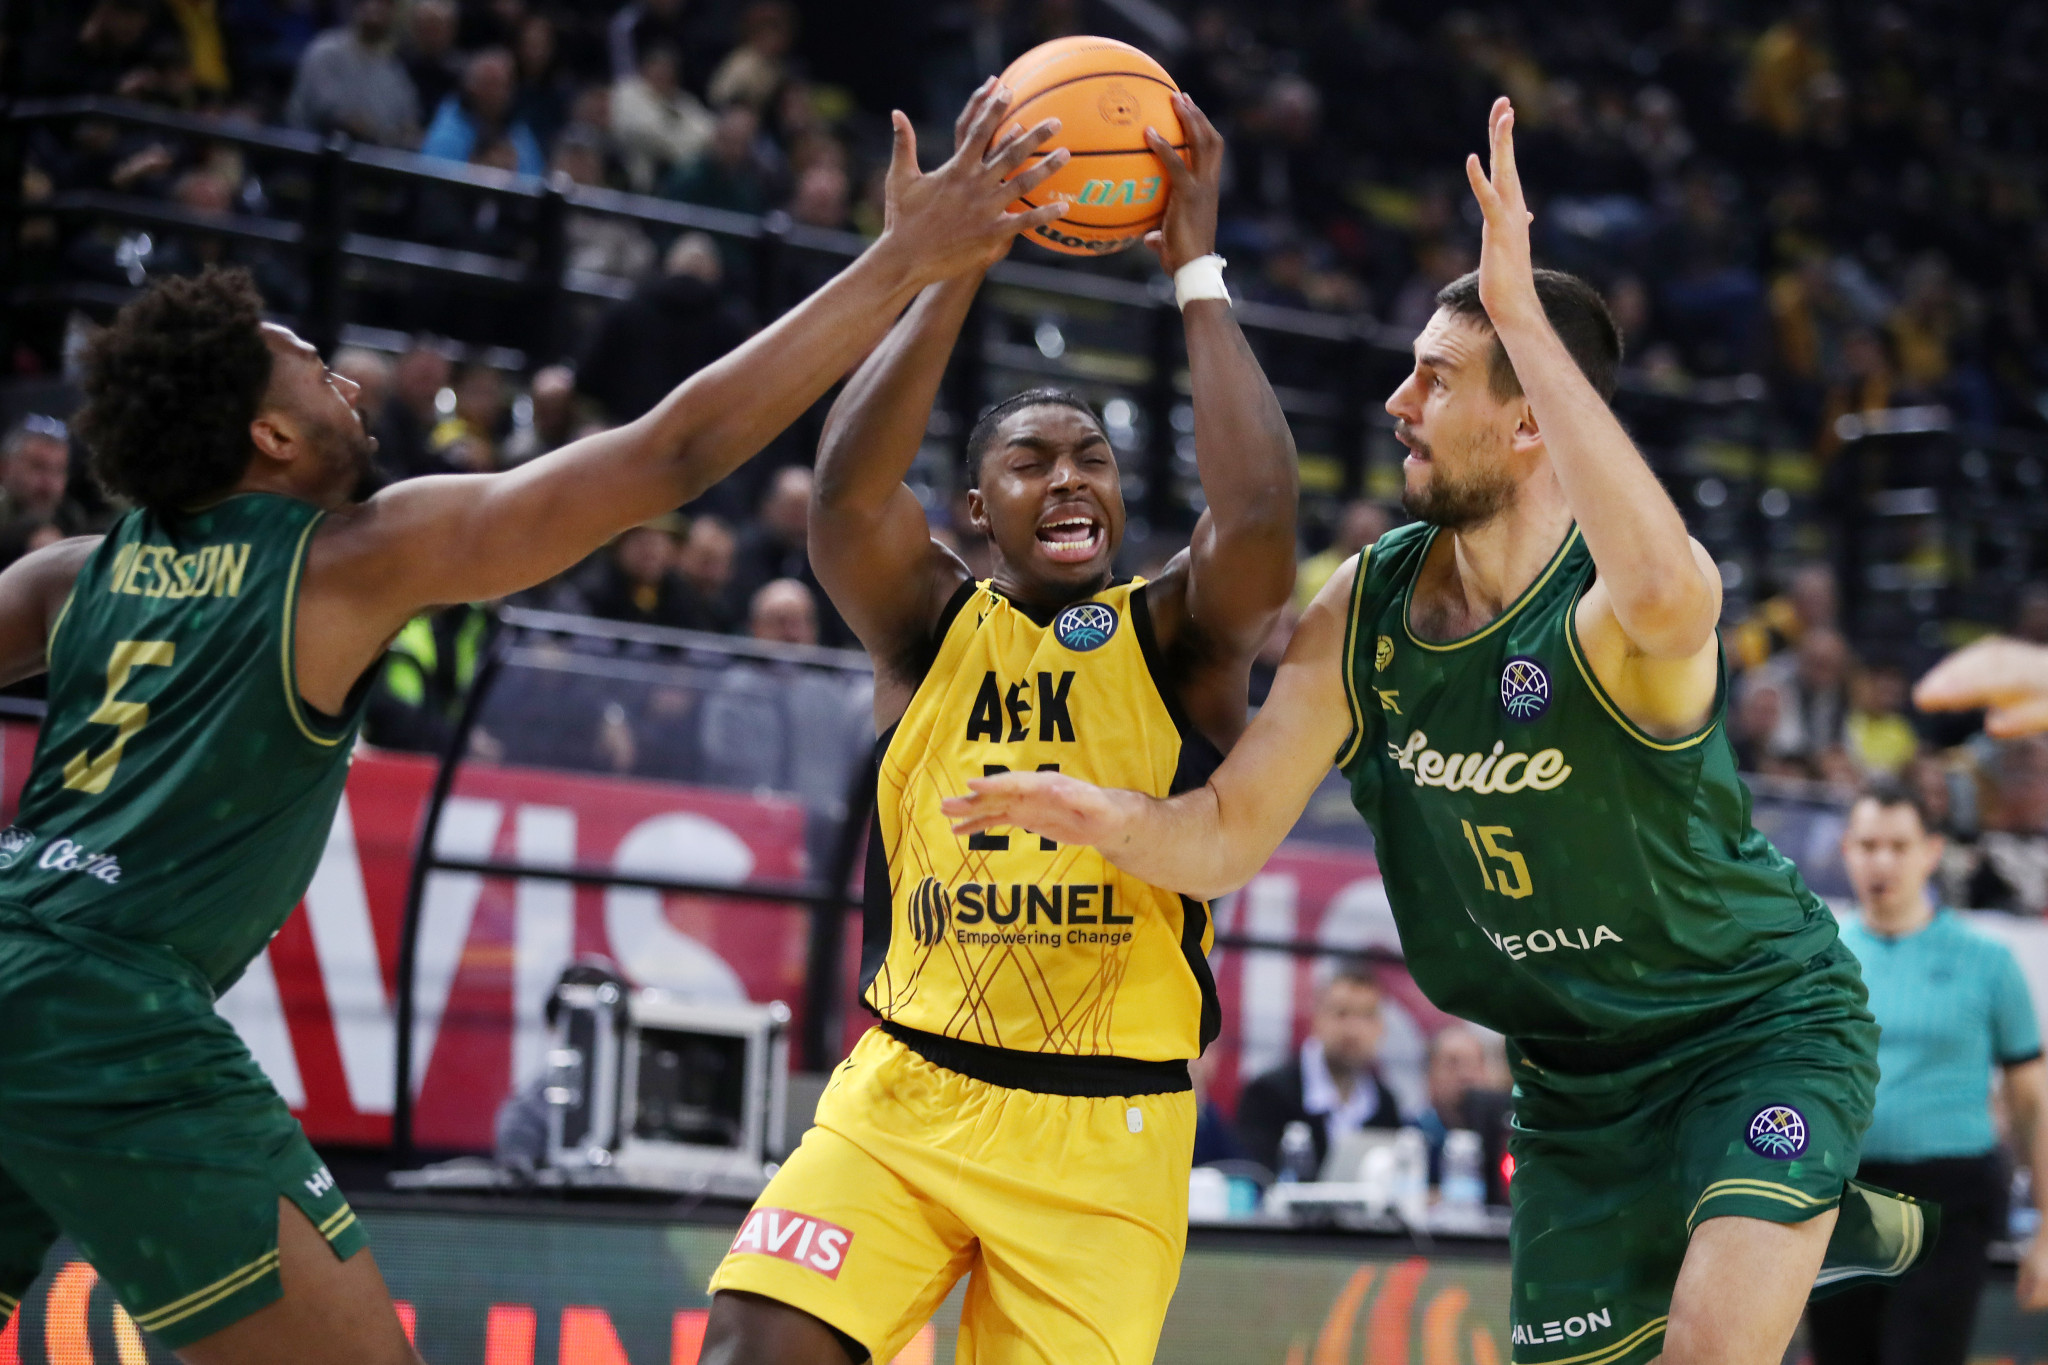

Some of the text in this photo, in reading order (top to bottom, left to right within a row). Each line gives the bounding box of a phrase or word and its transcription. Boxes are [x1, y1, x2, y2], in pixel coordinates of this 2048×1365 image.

[63, 641, 175, 794] 5
[966, 671, 1076, 743] AEK
[1388, 729, 1572, 795] Levice
[1461, 819, 1533, 899] 15
[956, 883, 1134, 926] SUNEL
[957, 929, 1132, 949] Empowering Change
[1482, 925, 1623, 961] VEOLIA
[733, 1212, 848, 1271] AVIS
